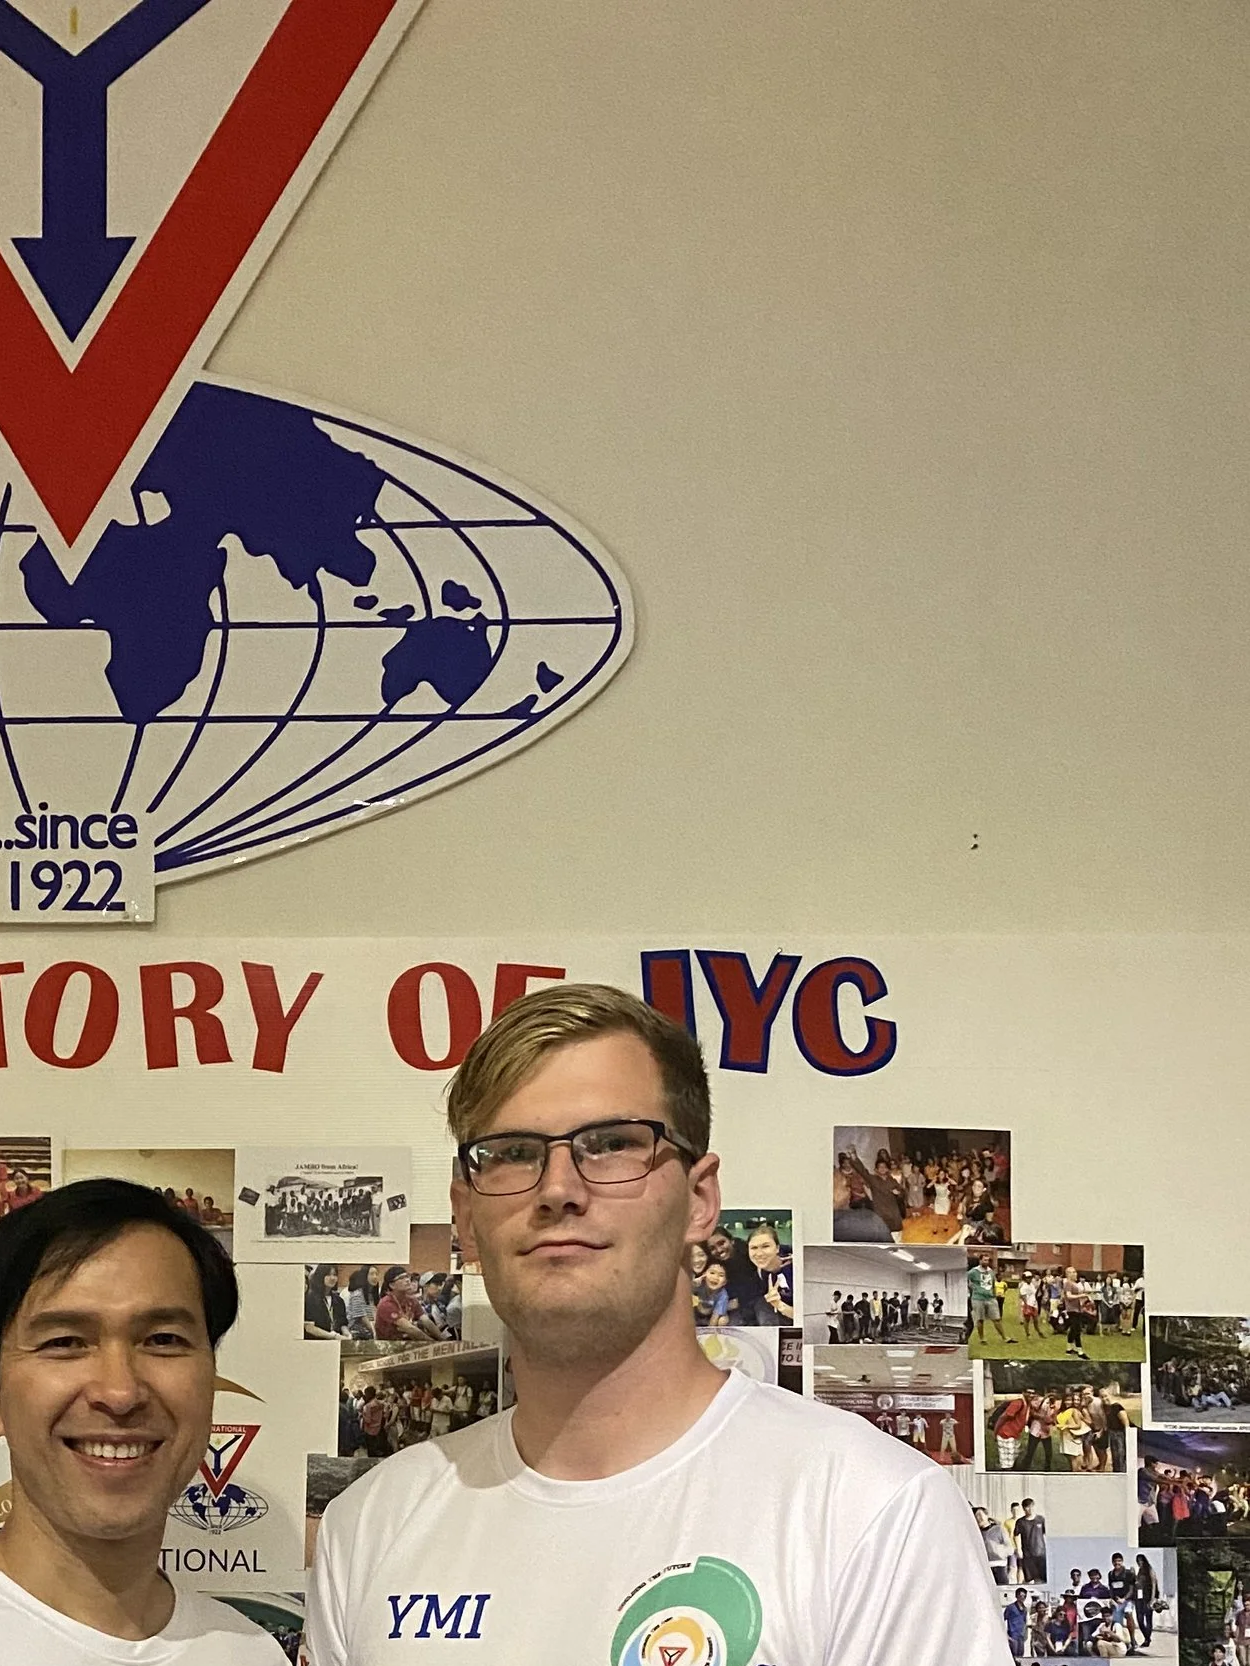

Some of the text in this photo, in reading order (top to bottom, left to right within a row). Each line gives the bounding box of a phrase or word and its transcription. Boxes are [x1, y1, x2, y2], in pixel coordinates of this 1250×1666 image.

[10, 859, 126, 911] 1922
[641, 948, 898, 1078] IYC
[413, 1349, 429, 1360] THE
[211, 1425, 247, 1433] NATIONAL
[160, 1549, 267, 1573] TIONAL
[387, 1593, 492, 1639] YMI
